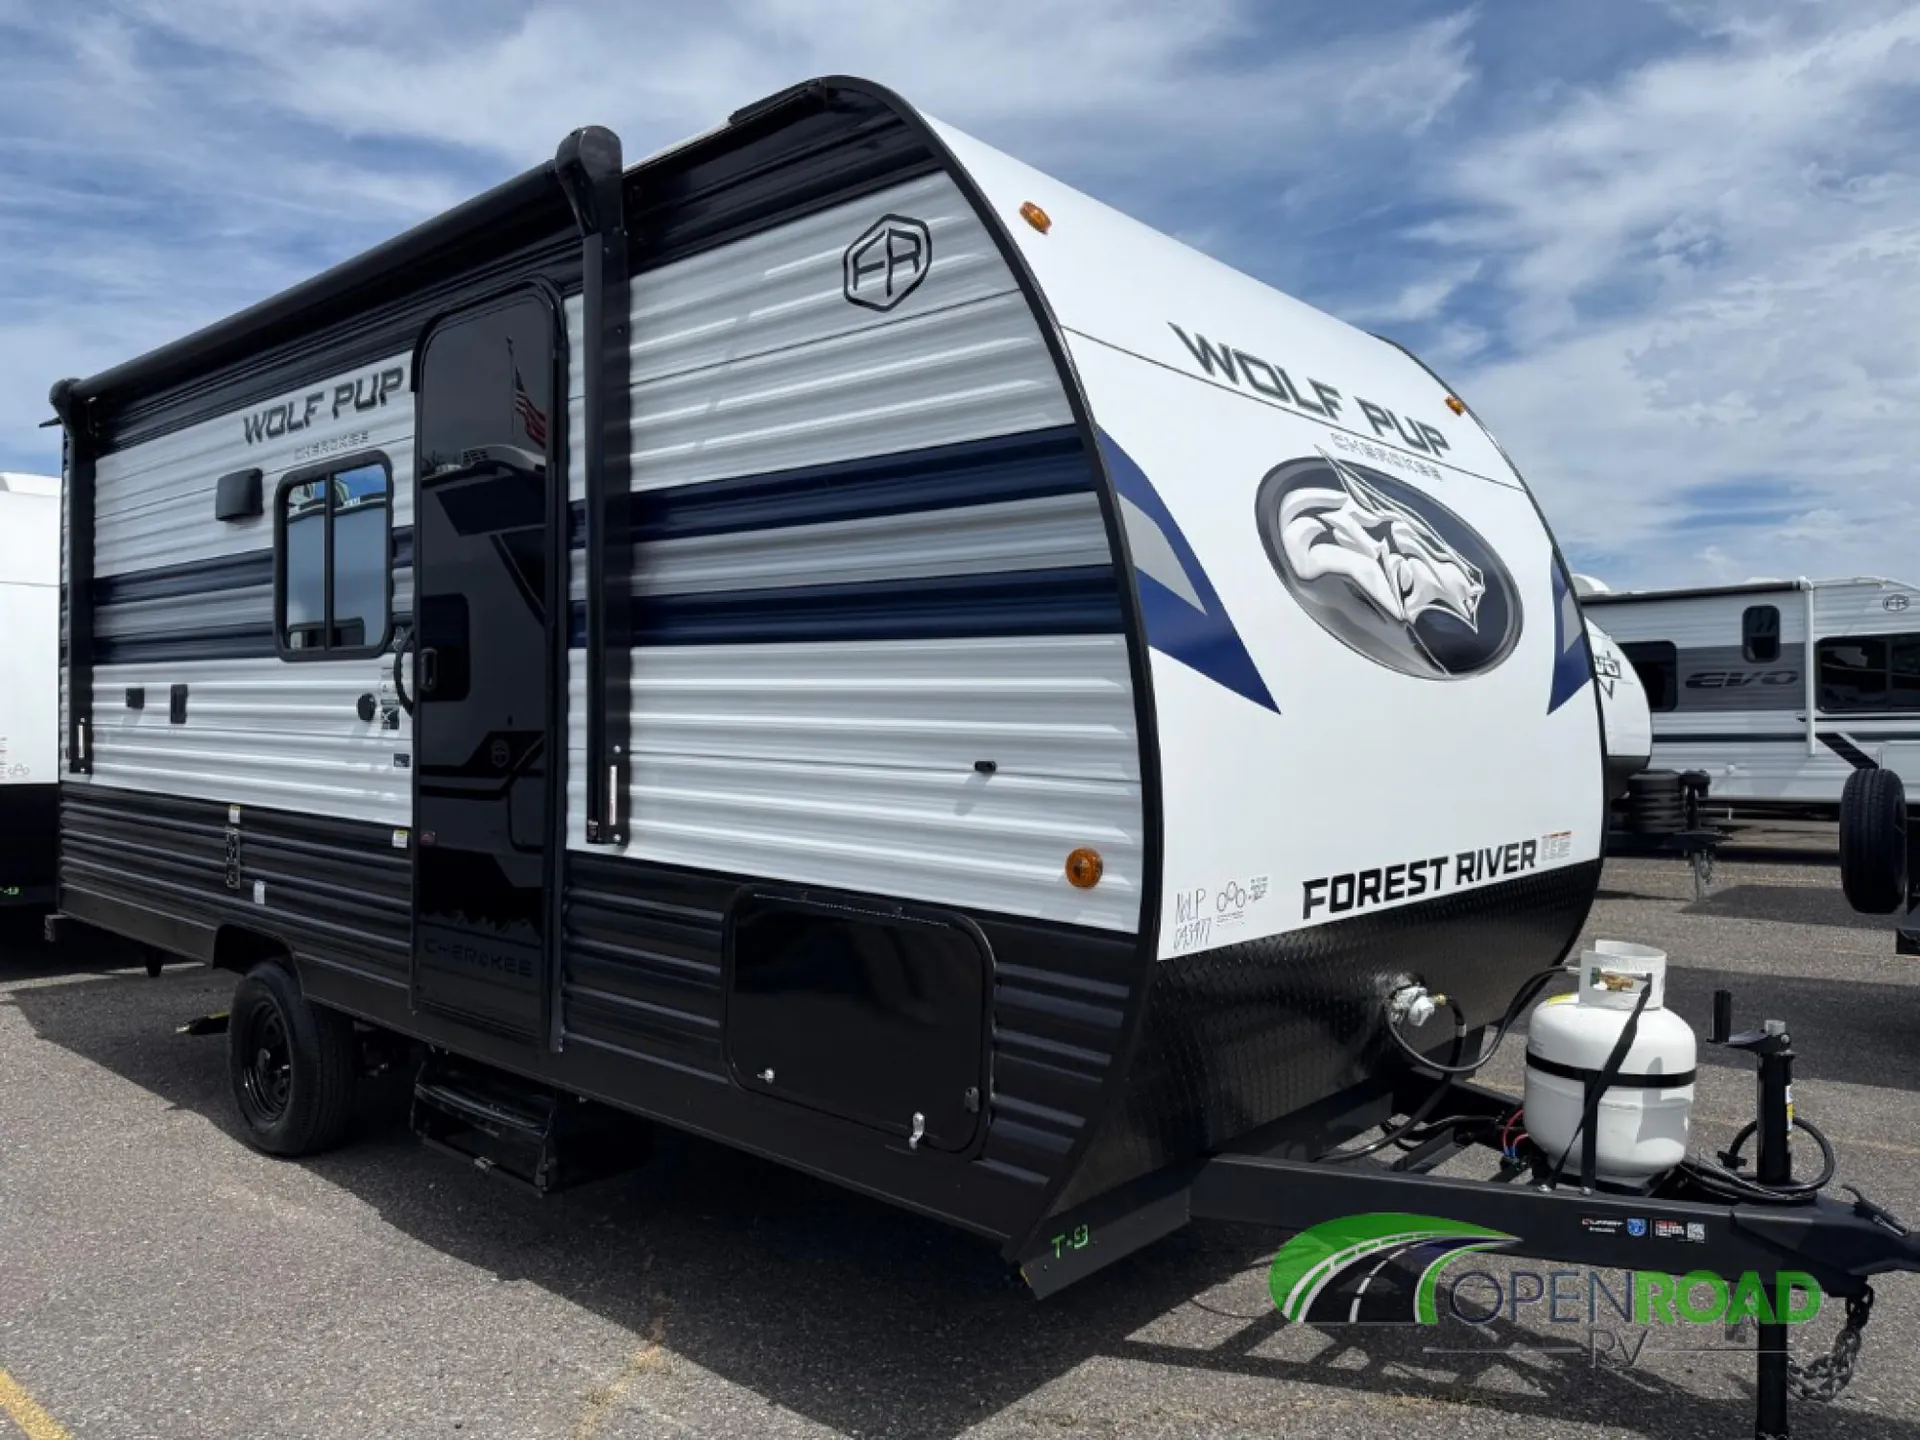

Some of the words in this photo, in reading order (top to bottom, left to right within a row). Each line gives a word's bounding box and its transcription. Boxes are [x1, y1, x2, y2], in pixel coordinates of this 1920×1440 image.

[243, 391, 325, 445] WOLF
[332, 367, 404, 420] PUP
[1168, 321, 1343, 420] WOLF
[1355, 396, 1450, 458] PUP
[1685, 670, 1799, 690] EVO
[1302, 856, 1450, 920] FOREST
[1455, 839, 1537, 886] RIVER
[424, 939, 533, 978] CHEROKEE
